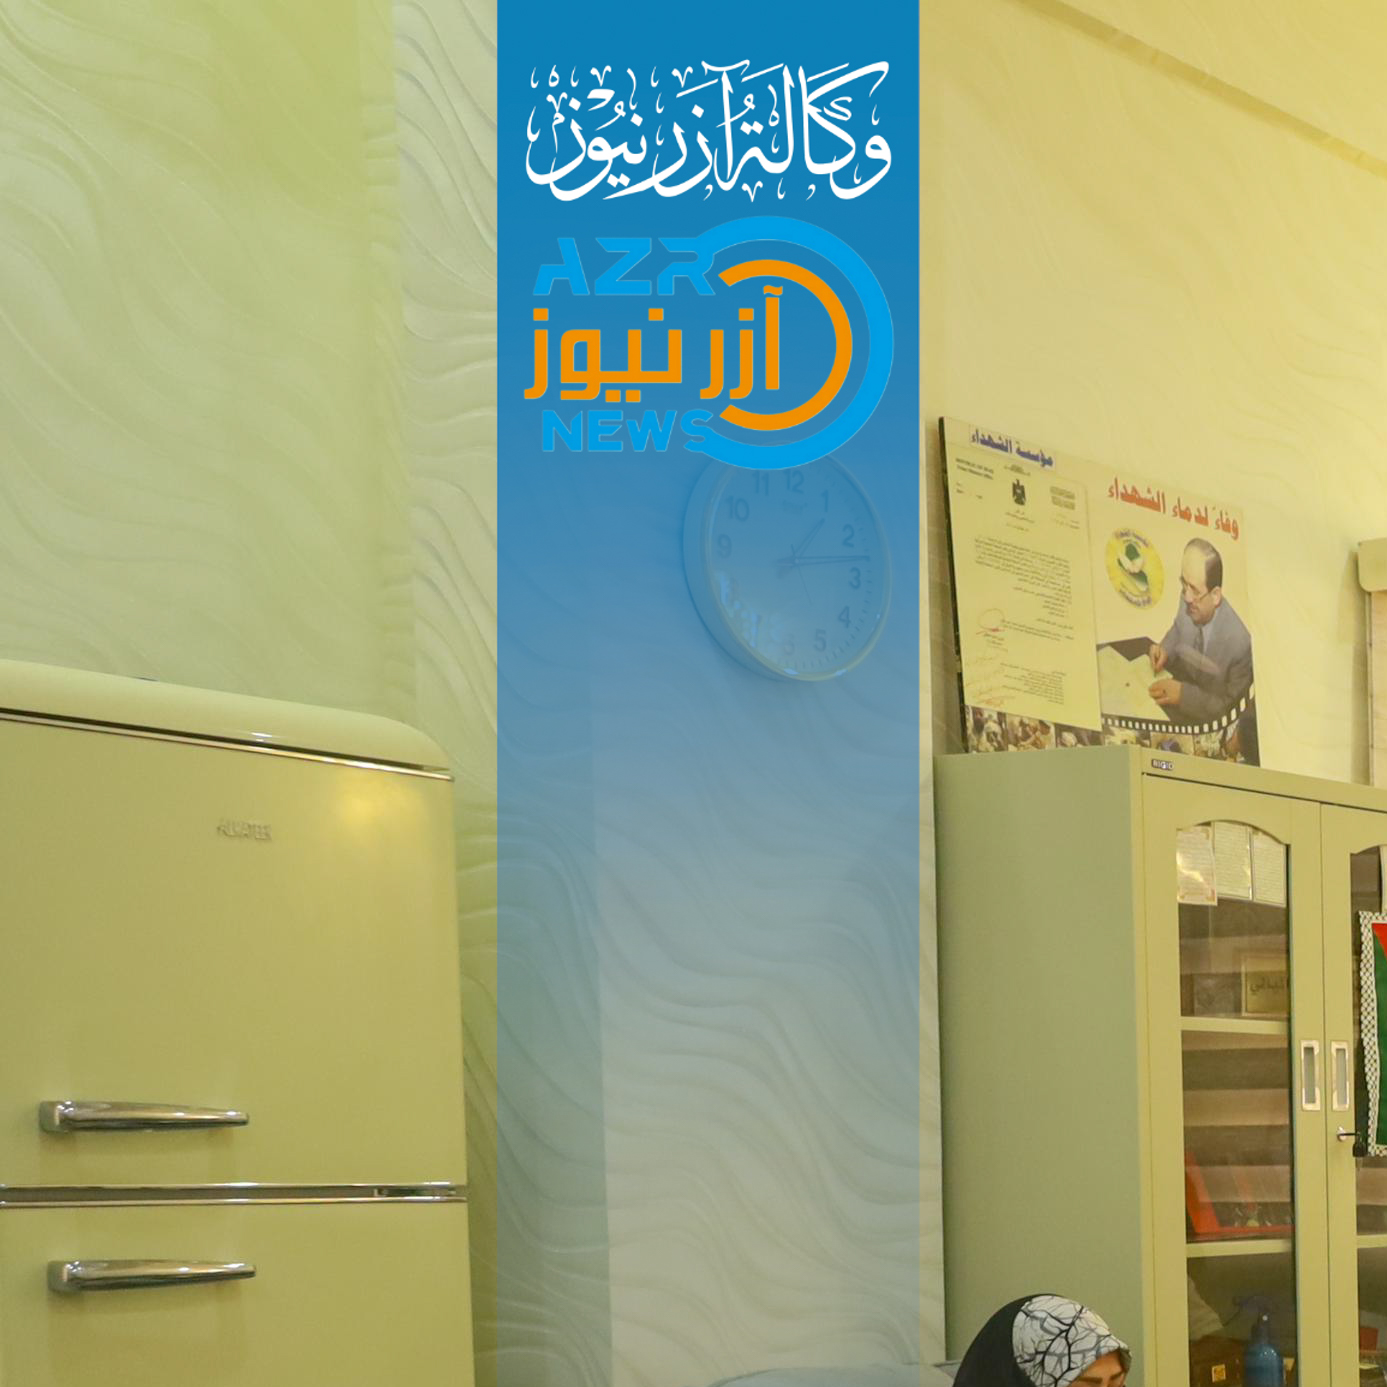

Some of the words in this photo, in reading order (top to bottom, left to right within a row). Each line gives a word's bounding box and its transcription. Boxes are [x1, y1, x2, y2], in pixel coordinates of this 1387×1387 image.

[971, 428, 1013, 454] الشهداء
[784, 469, 806, 494] 12
[1108, 476, 1166, 514] الشهداء
[725, 494, 750, 522] 10
[1172, 496, 1209, 526] لدماء
[842, 523, 856, 548] 2
[848, 567, 862, 590] 3
[838, 605, 852, 629] 4
